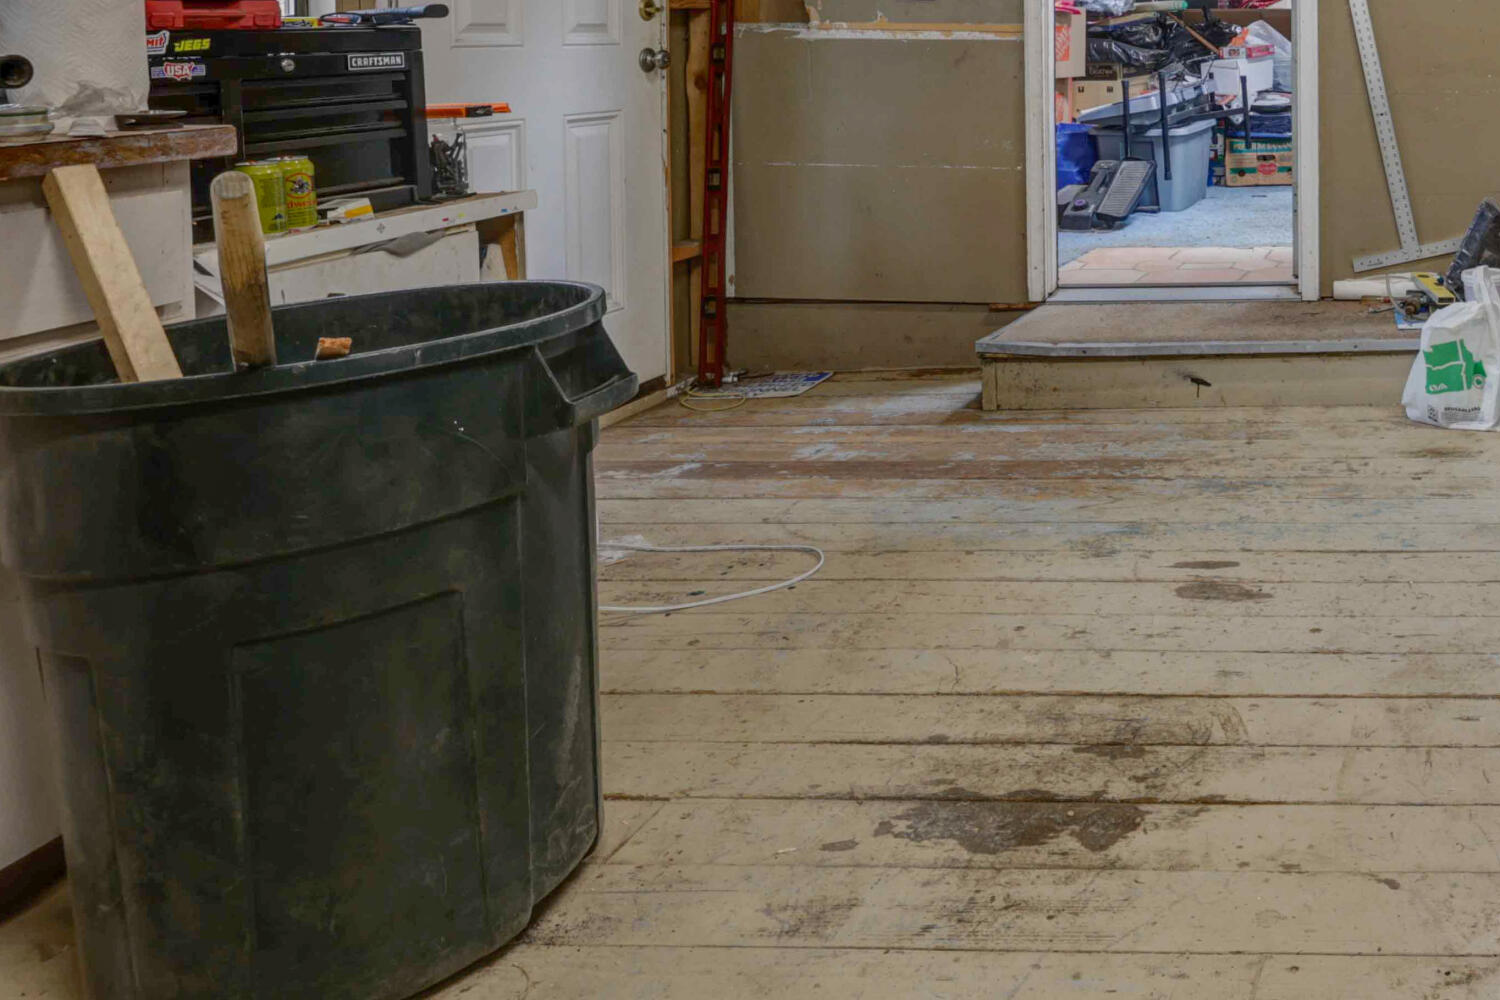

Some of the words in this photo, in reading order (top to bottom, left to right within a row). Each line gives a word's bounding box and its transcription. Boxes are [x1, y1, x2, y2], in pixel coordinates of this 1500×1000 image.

[174, 39, 211, 52] JEGS
[352, 56, 402, 67] CRAFTSMAN
[167, 64, 192, 75] USA
